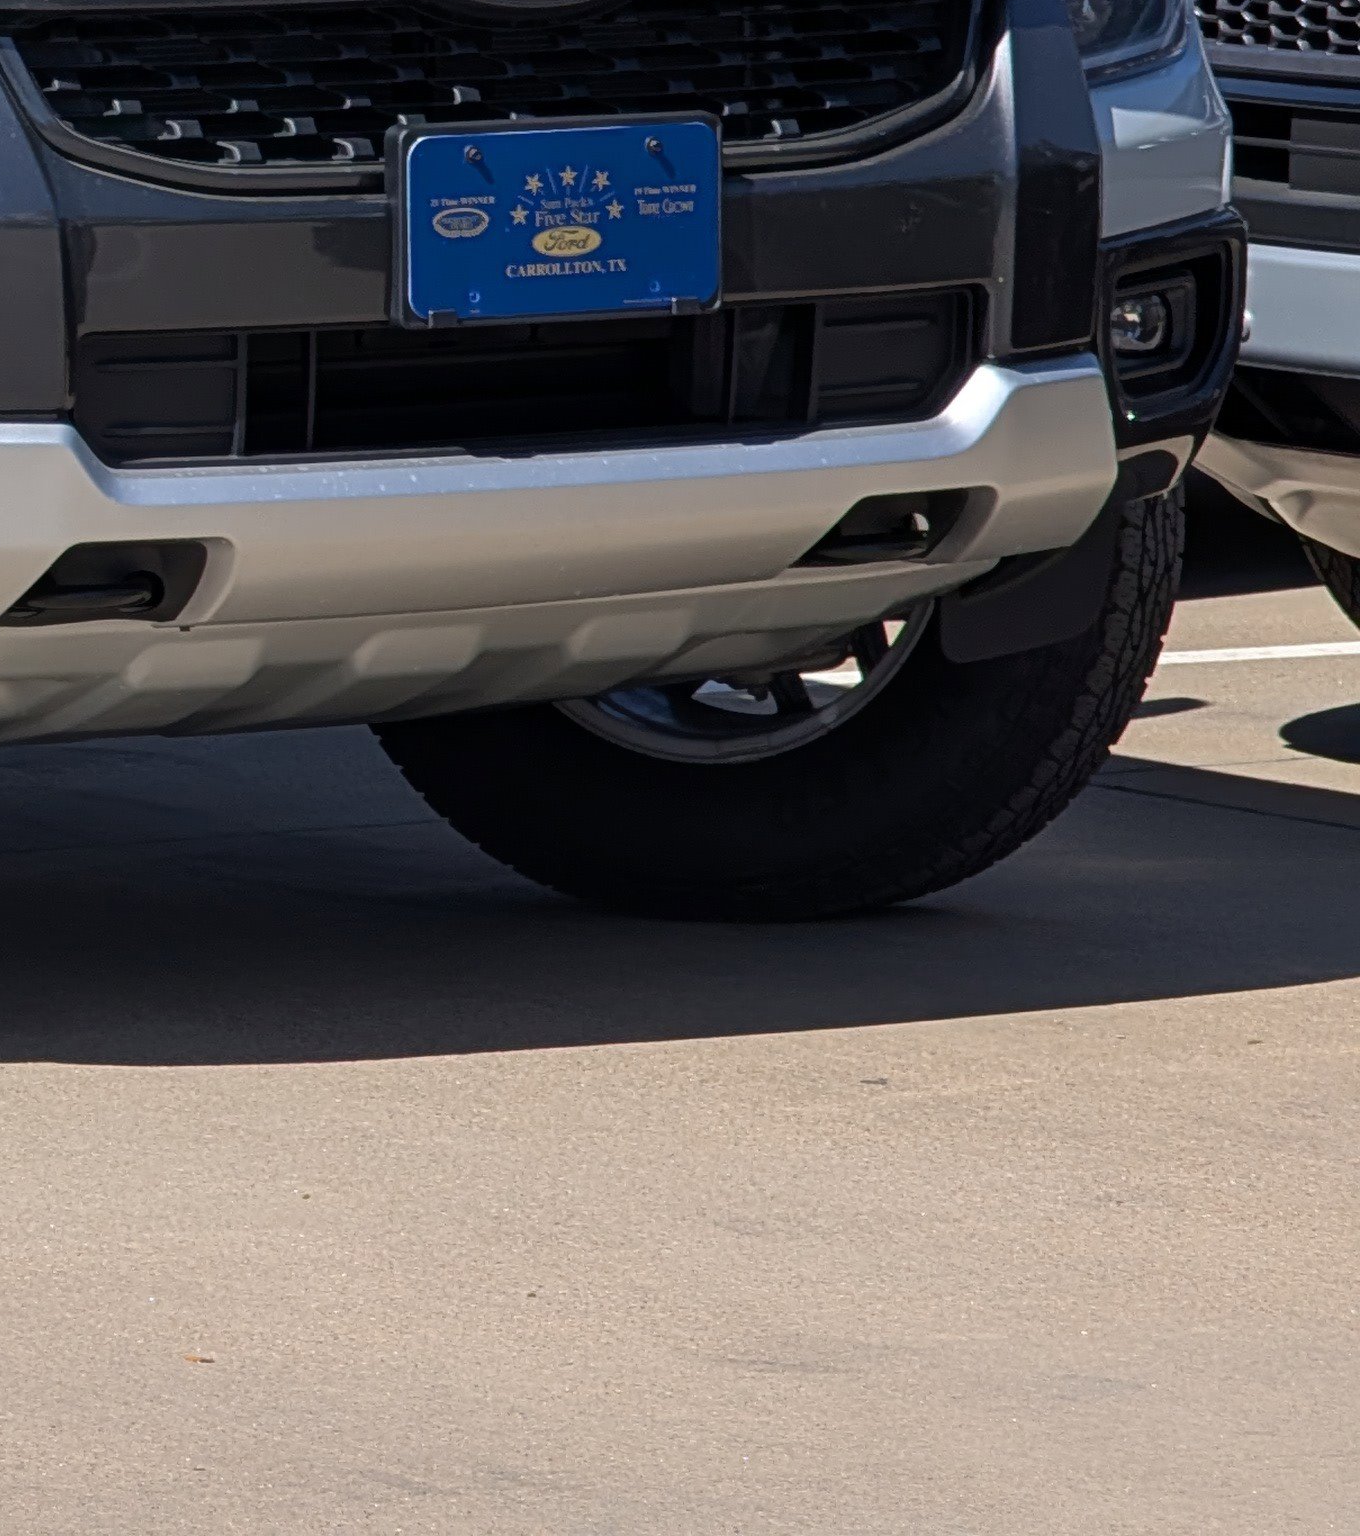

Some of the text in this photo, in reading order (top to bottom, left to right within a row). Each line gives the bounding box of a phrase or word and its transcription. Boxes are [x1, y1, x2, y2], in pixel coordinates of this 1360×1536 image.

[535, 208, 600, 227] Five Star
[544, 230, 590, 251] Ford
[607, 258, 628, 273] TX
